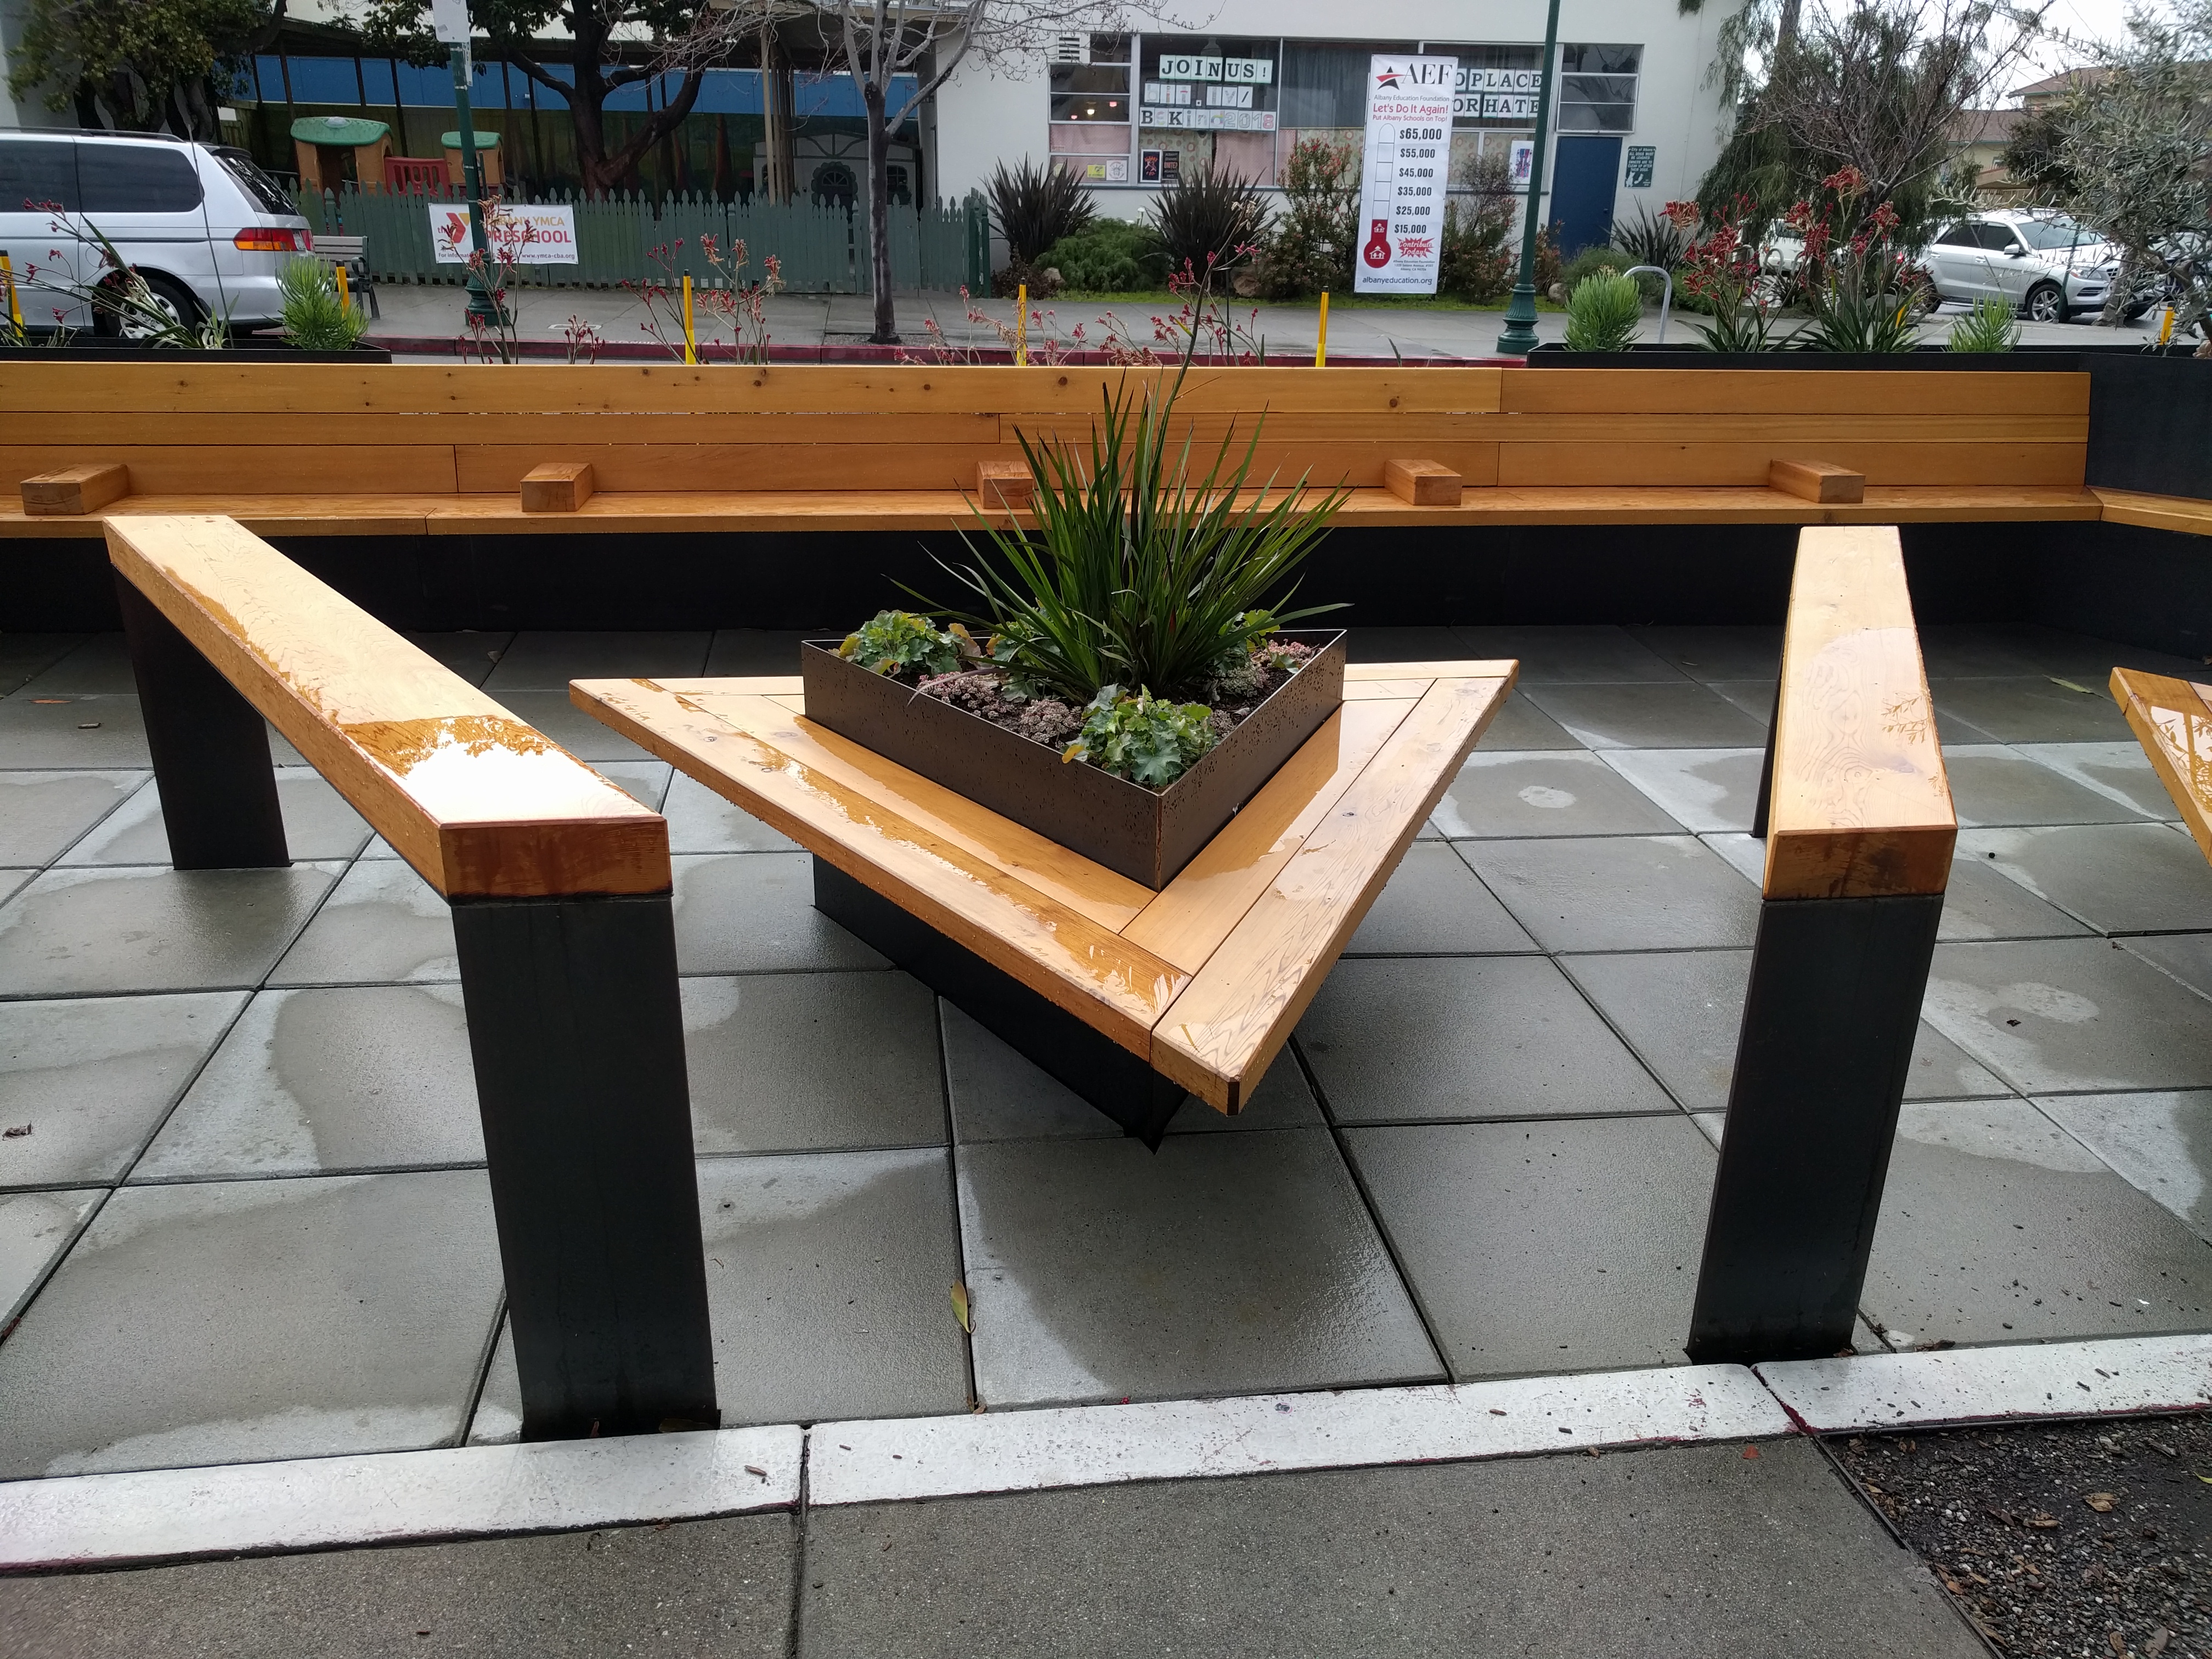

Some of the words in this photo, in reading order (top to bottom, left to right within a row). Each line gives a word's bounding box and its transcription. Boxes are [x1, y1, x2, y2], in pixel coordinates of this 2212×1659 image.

[1161, 59, 1221, 77] JOIN
[1227, 63, 1266, 78] US!
[1400, 63, 1453, 84] AEF
[1471, 73, 1542, 88] PLACE
[1373, 103, 1393, 112] Let's
[1396, 104, 1409, 113] Do
[1410, 104, 1417, 113] It
[1419, 105, 1448, 116] Again!
[1484, 99, 1539, 113] HATE
[1400, 128, 1442, 140] $65,000
[1400, 149, 1436, 159] $55,000
[1399, 168, 1434, 178] $45,000
[1397, 187, 1432, 197] $35,000
[1396, 206, 1430, 216] $25,000
[532, 216, 565, 226] YMCA
[1394, 224, 1426, 234] $15,000
[1403, 247, 1426, 257] Today!
[1362, 276, 1432, 285] albanyeducation.org
